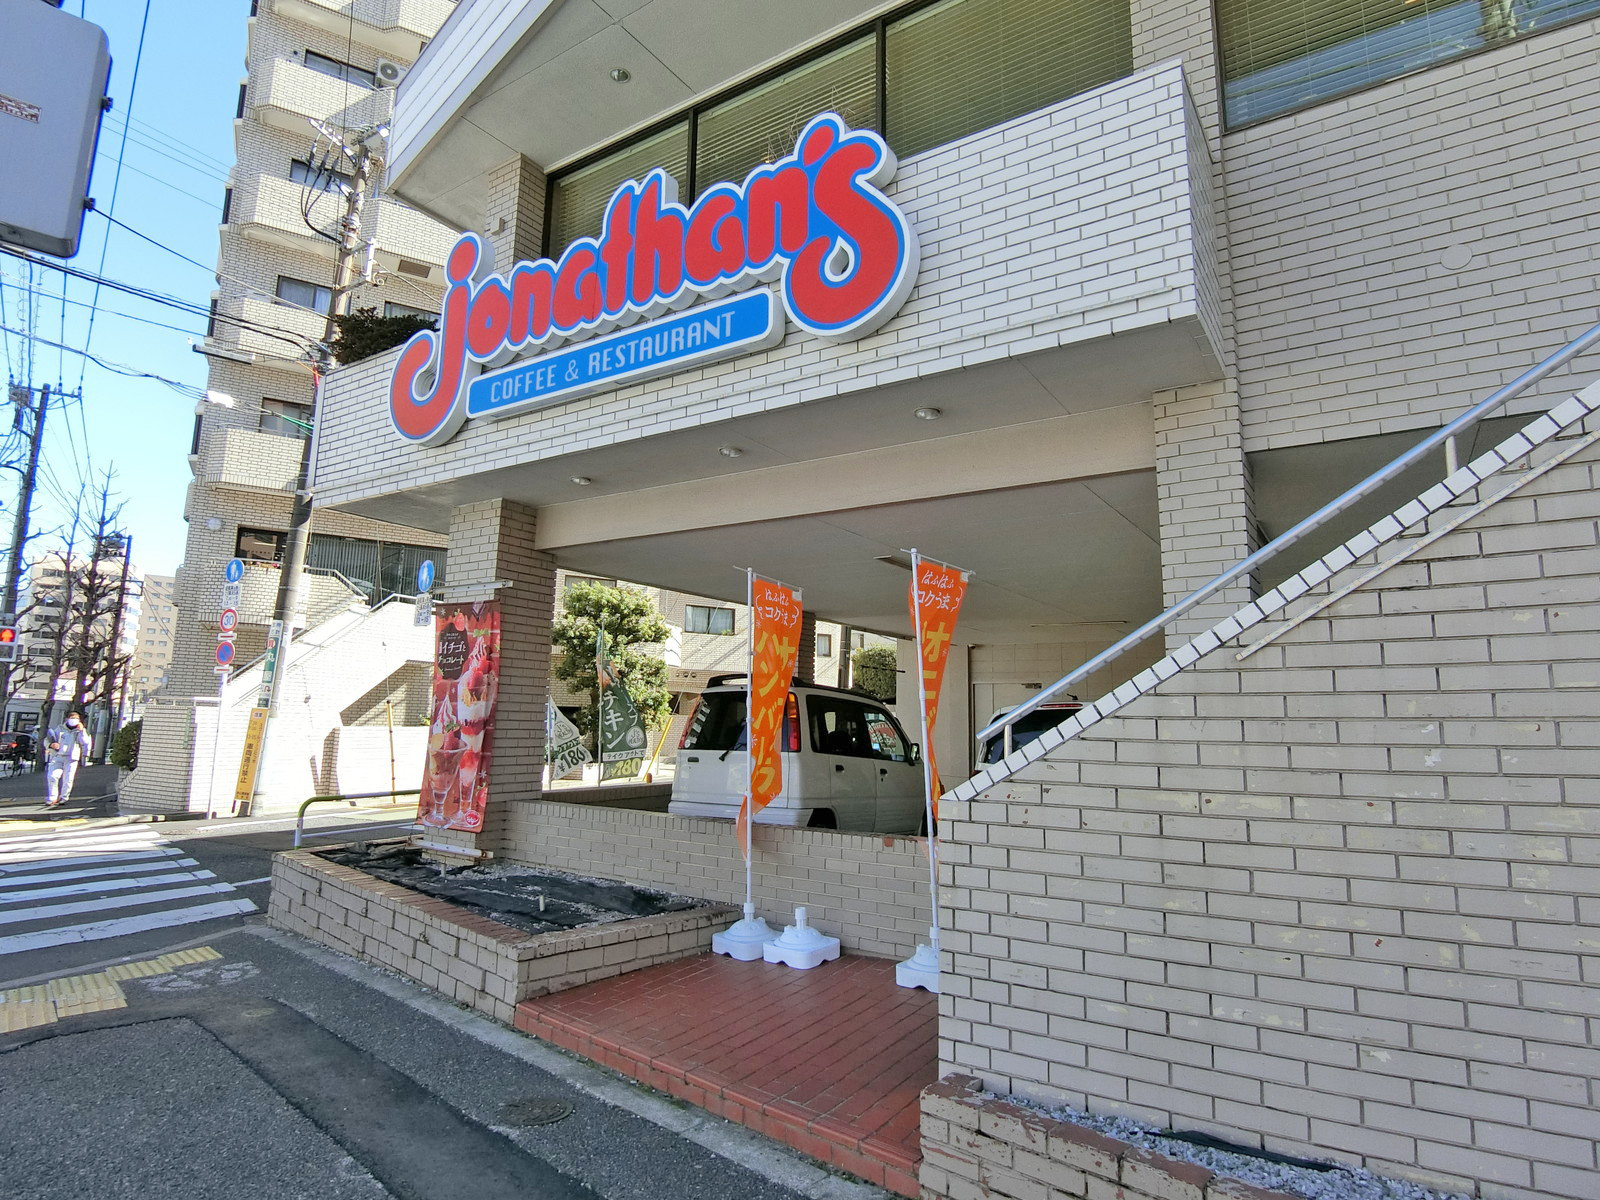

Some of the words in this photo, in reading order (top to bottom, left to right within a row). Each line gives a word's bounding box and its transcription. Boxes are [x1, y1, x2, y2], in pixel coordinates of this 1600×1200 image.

[490, 364, 558, 403] COFFEE
[564, 359, 579, 382] &
[588, 310, 736, 376] RESTAURANT
[921, 570, 954, 589] はふはふ
[223, 615, 234, 627] 30
[438, 654, 465, 665] チョコレート
[603, 690, 625, 750] チキン
